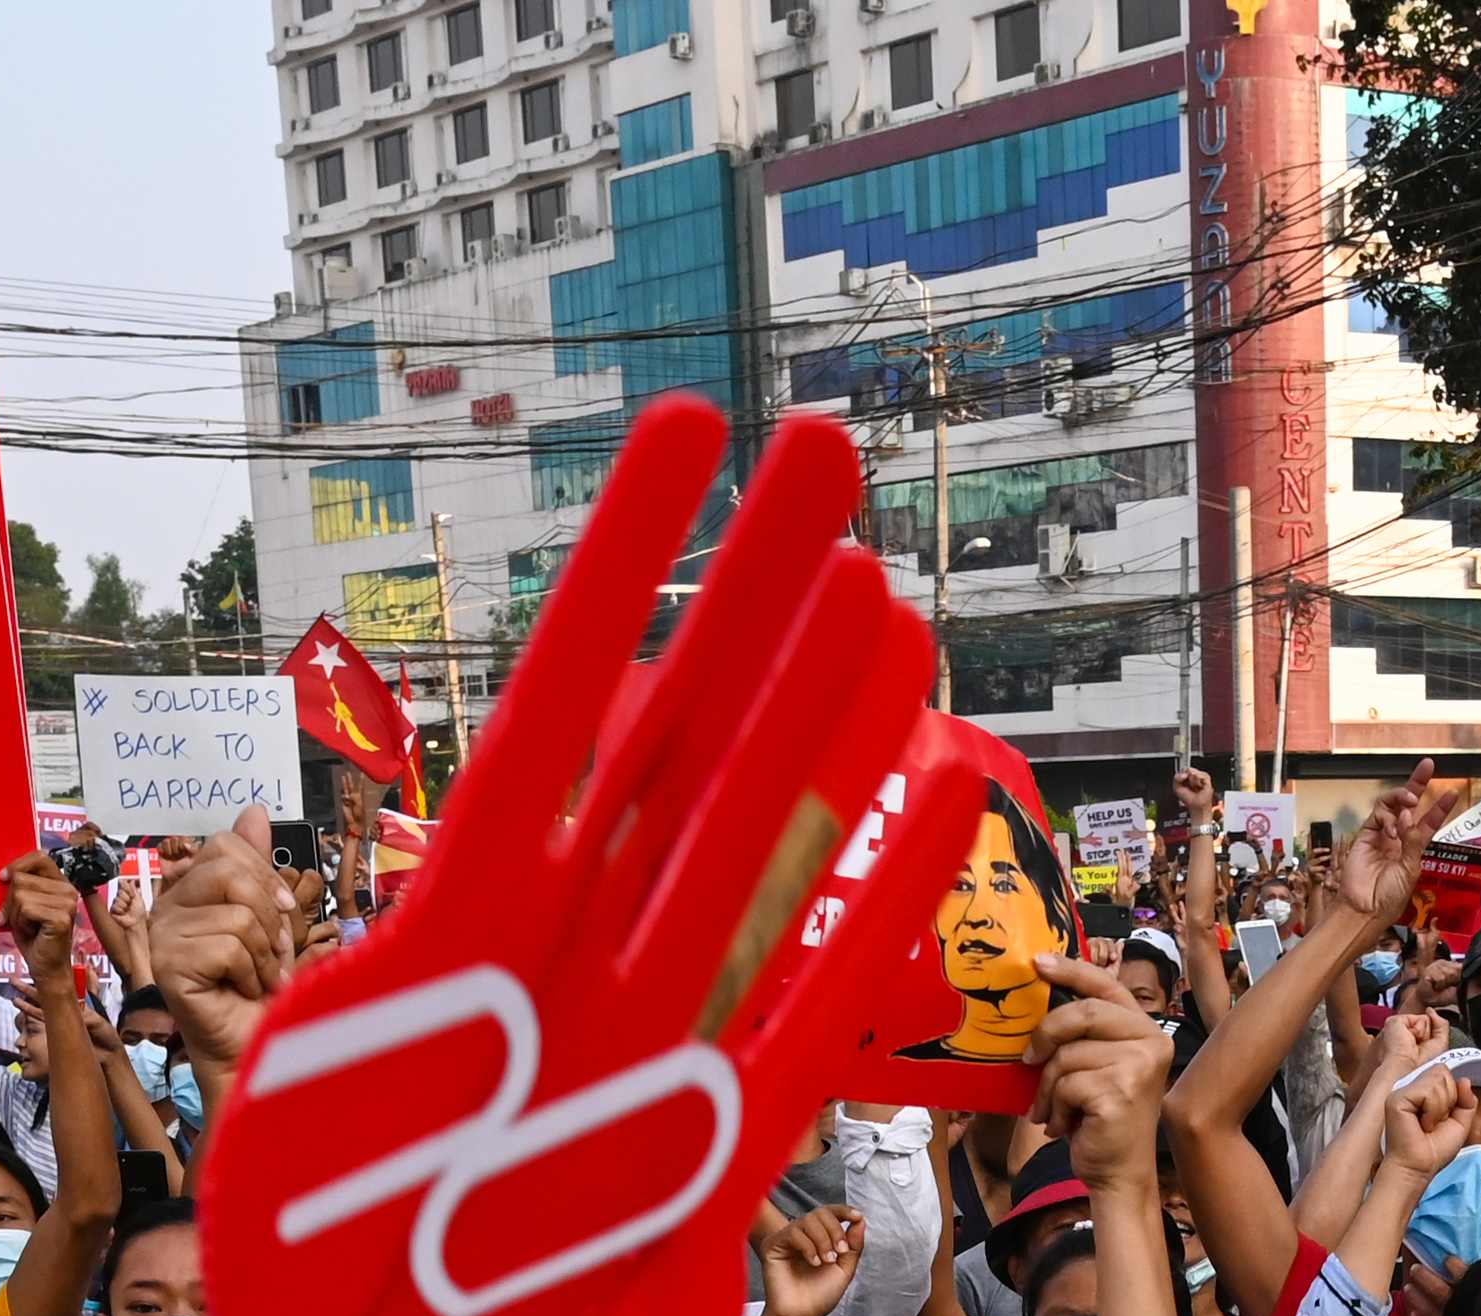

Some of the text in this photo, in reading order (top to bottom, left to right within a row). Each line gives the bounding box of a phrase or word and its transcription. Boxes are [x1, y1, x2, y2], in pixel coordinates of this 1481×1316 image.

[131, 688, 282, 717] SOLDIERS
[114, 731, 255, 763] BACK TO
[1087, 808, 1133, 822] HELP US
[44, 817, 84, 832] LEAD
[1086, 849, 1111, 860] STOP
